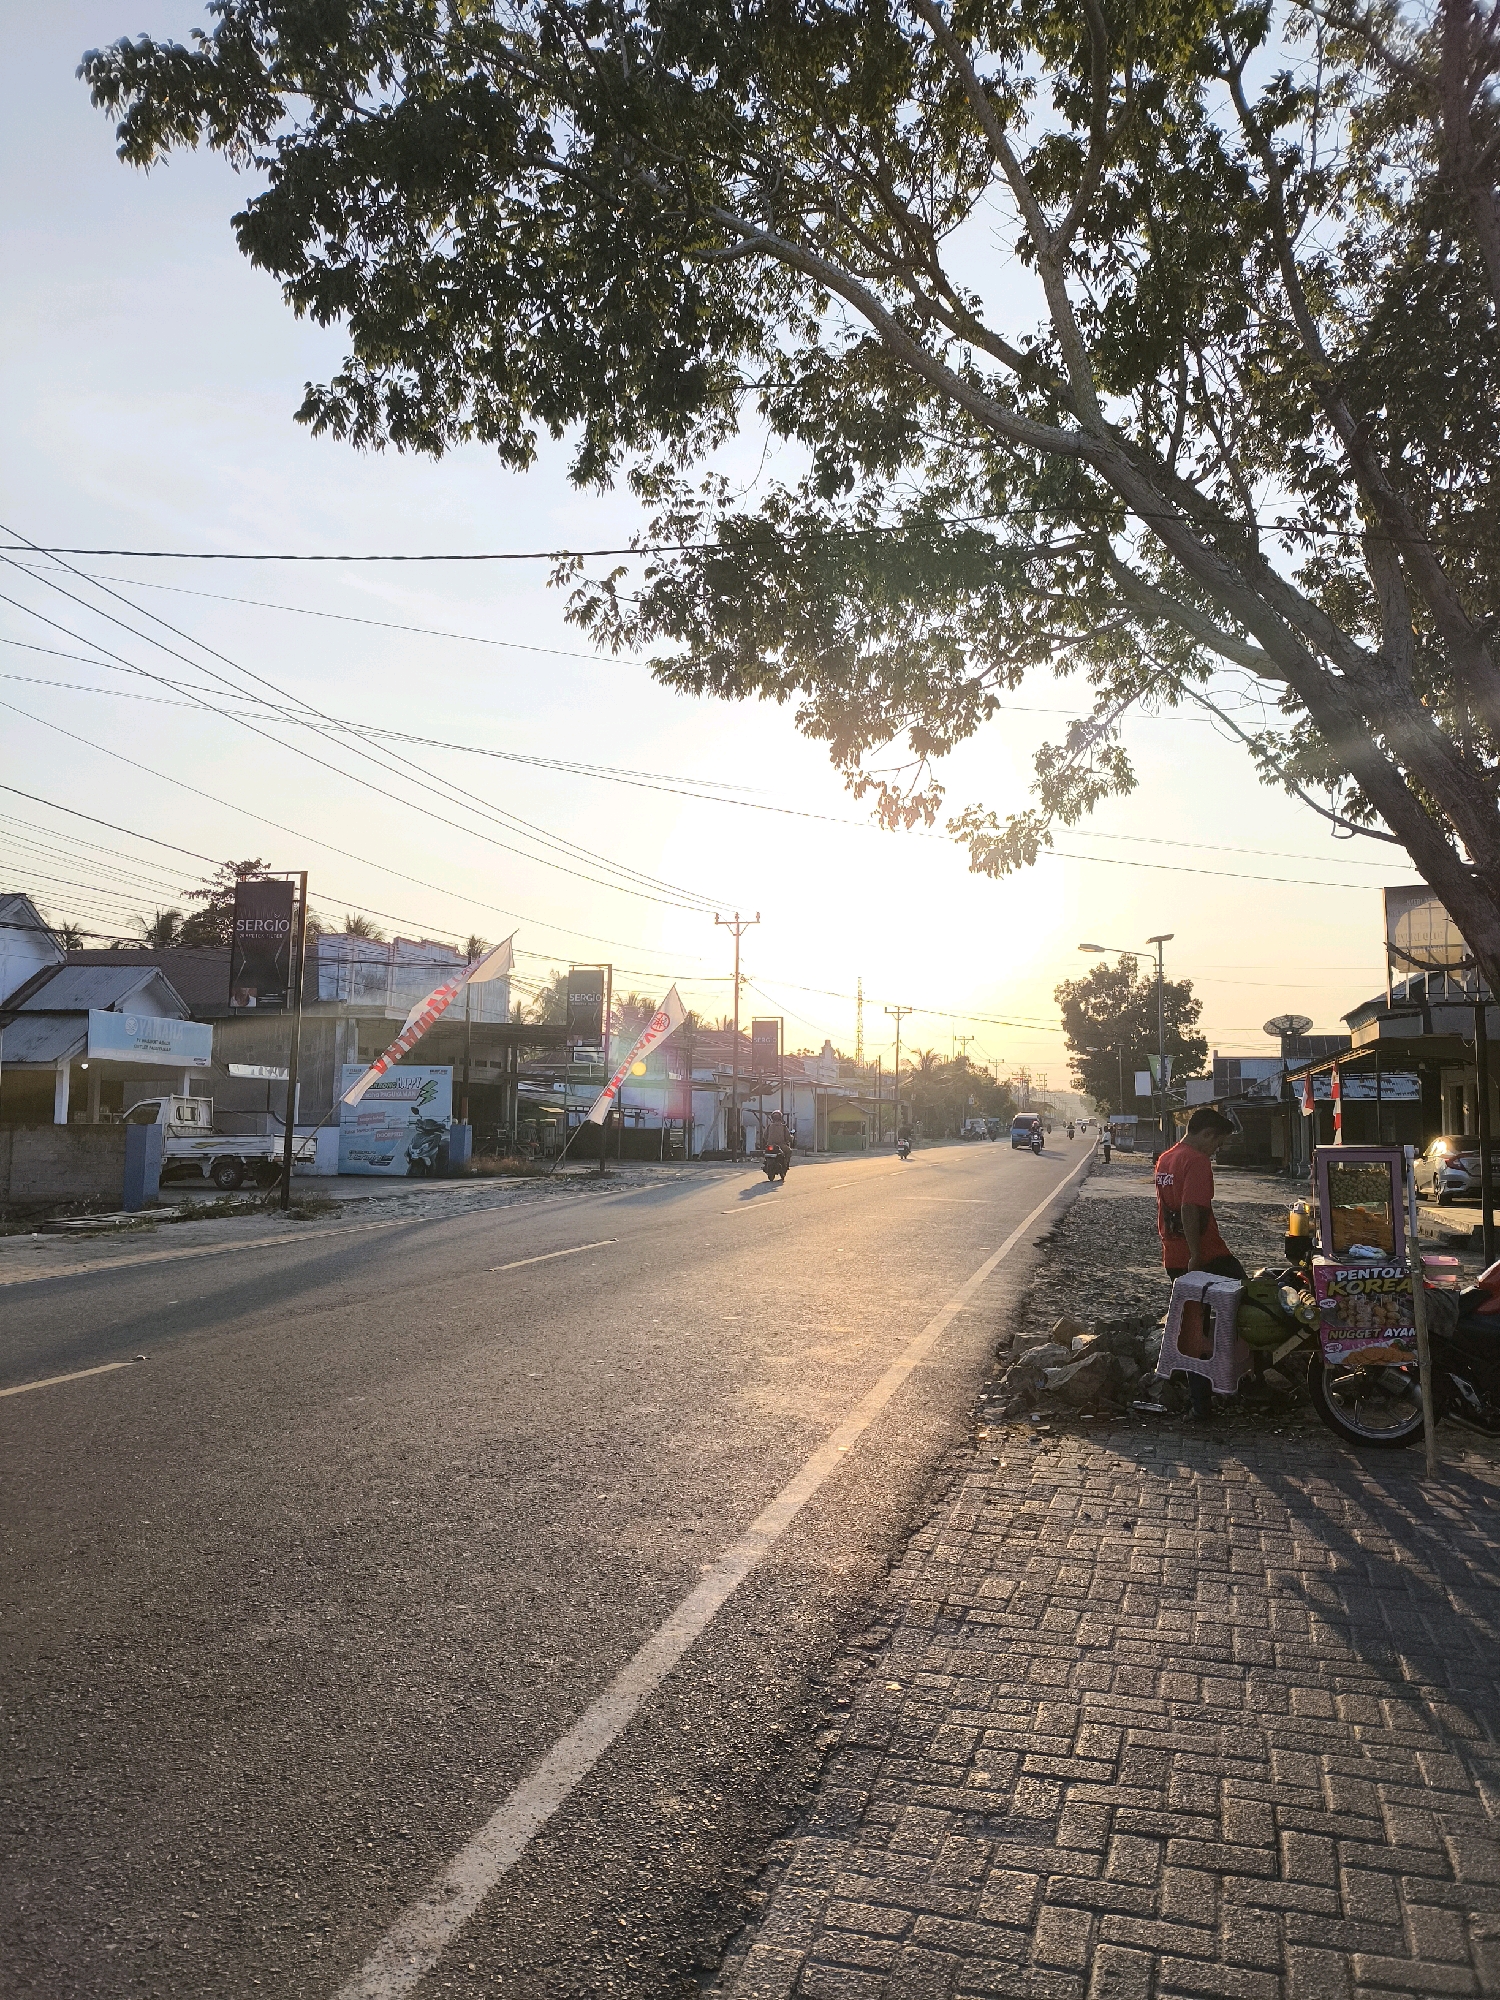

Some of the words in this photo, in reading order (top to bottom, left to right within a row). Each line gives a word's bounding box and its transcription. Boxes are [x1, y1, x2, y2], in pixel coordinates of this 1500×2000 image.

[236, 917, 290, 932] SERGIO
[569, 993, 602, 1002] SERGIO
[140, 1019, 183, 1040] YAMAHA
[396, 1077, 422, 1089] HAPPY
[1335, 1267, 1404, 1281] PENTOL
[1327, 1278, 1413, 1297] KOREA
[1329, 1328, 1381, 1339] NUGGET
